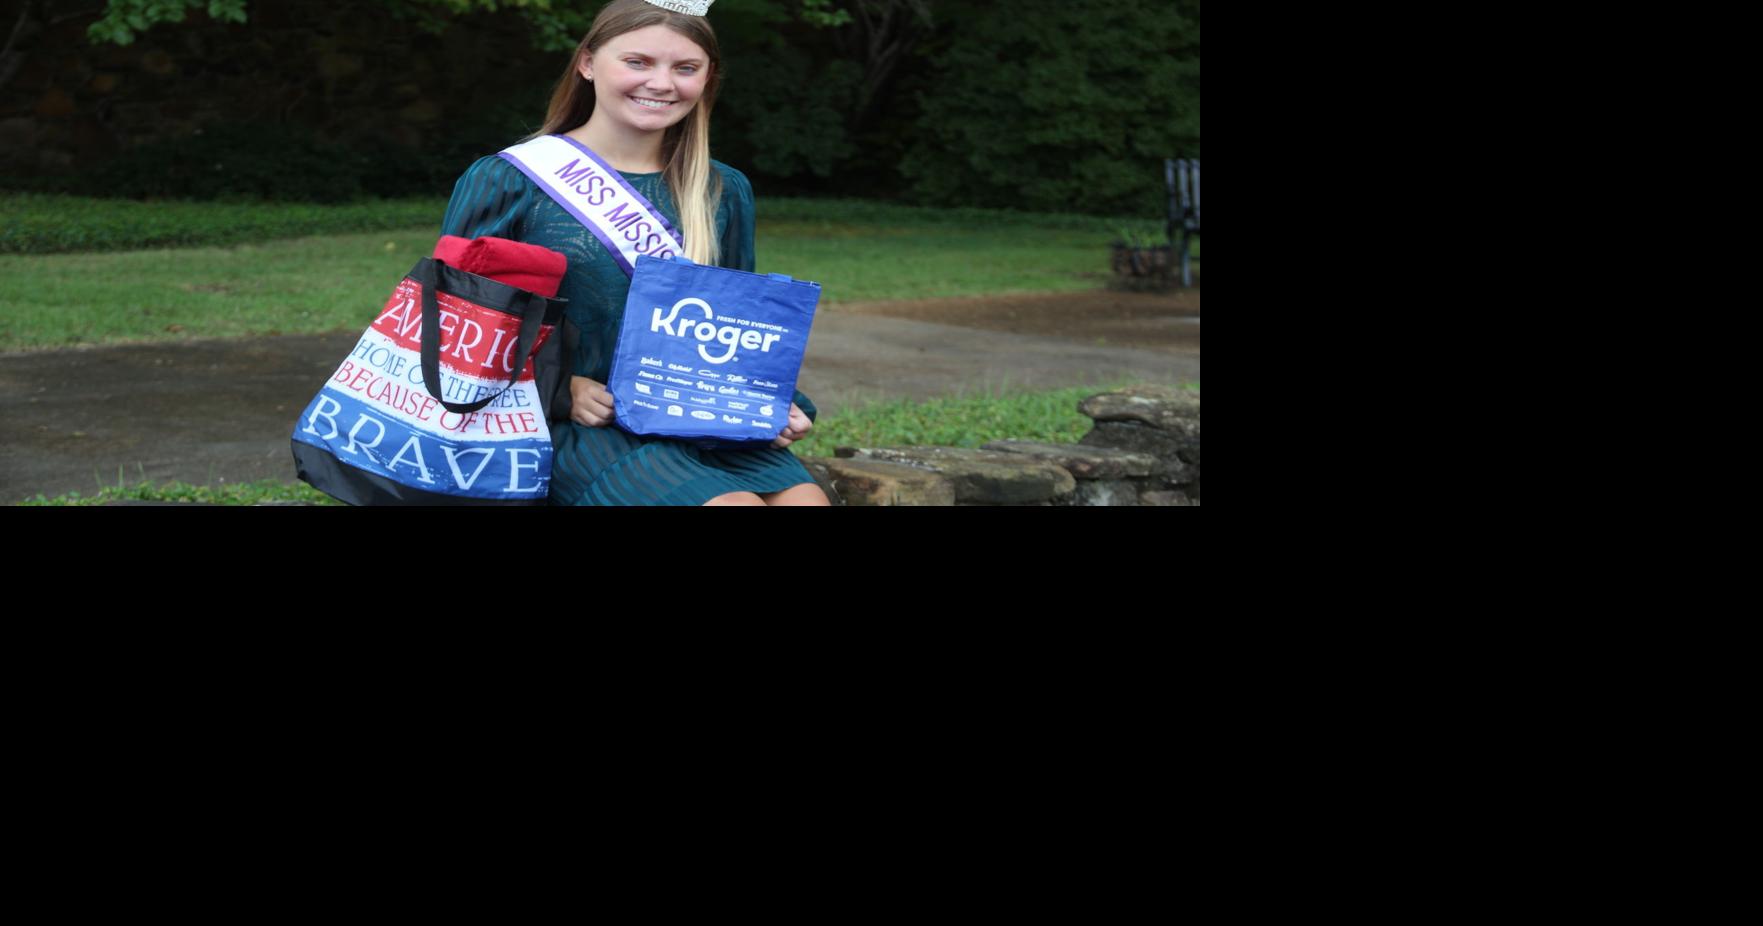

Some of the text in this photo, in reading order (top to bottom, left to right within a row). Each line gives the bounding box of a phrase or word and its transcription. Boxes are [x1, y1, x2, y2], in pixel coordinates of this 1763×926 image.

[554, 158, 615, 206] MISS
[650, 297, 780, 365] Kroger
[716, 315, 783, 332] FRESH FOR EVERYONE
[333, 361, 539, 434] BECAUSE OF THE
[408, 363, 445, 385] O
[303, 394, 542, 493] BRAVE
